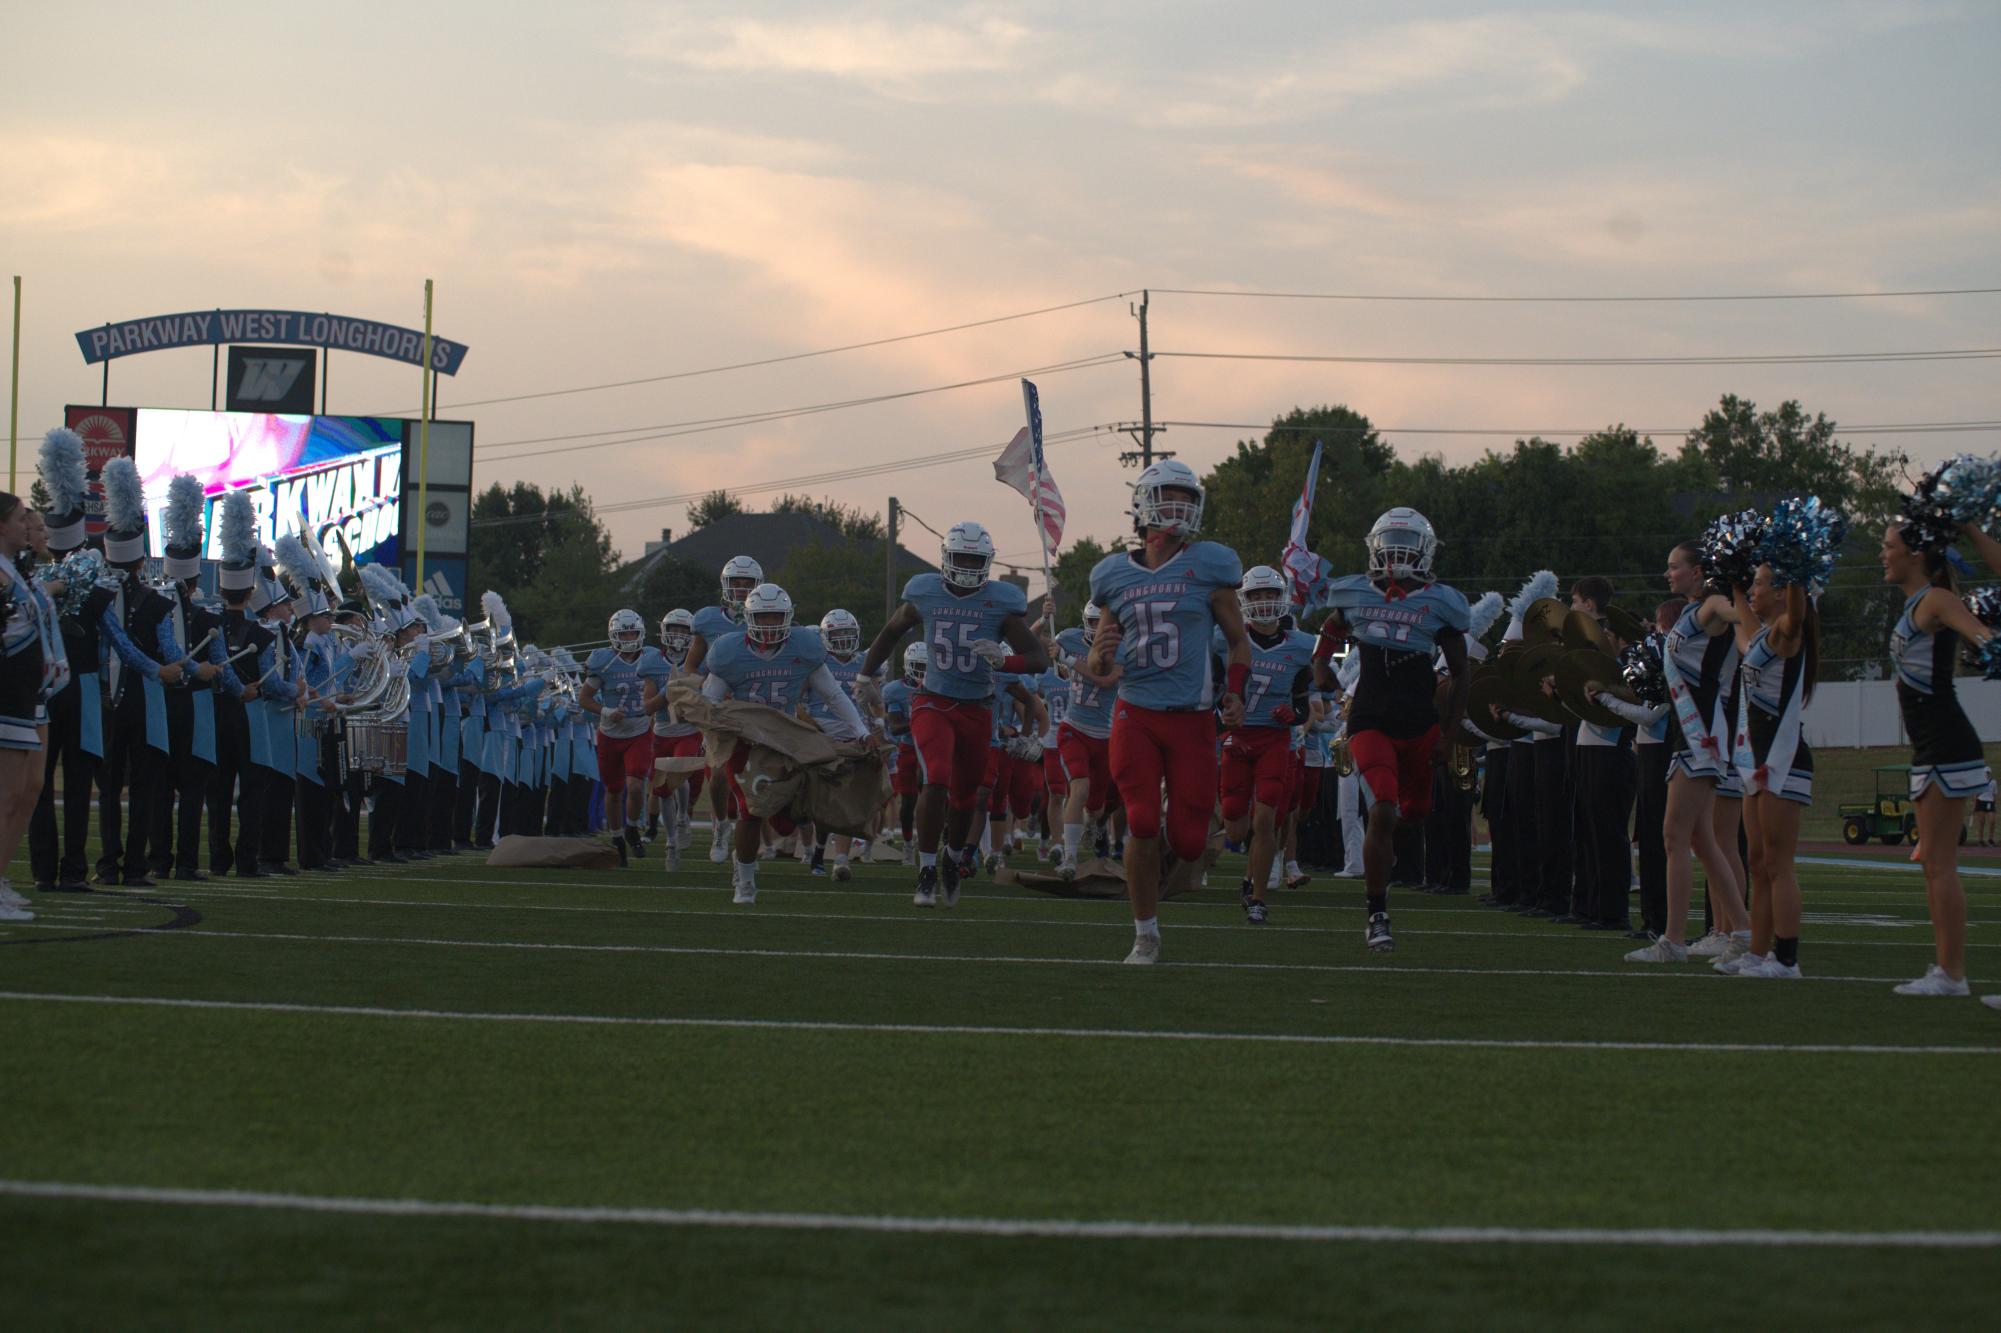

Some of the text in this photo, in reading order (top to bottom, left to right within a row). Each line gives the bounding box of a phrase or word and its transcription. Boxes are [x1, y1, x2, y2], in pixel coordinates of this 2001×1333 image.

[92, 314, 452, 368] PARKWAY WEST LONGHORNS
[434, 595, 462, 610] das
[1123, 583, 1187, 601] LONGHORNS
[1359, 606, 1424, 625] LONGHORNS
[933, 619, 980, 674] 55
[1133, 600, 1180, 669] 15
[1250, 659, 1287, 673] GHORNS
[1246, 672, 1273, 713] 7
